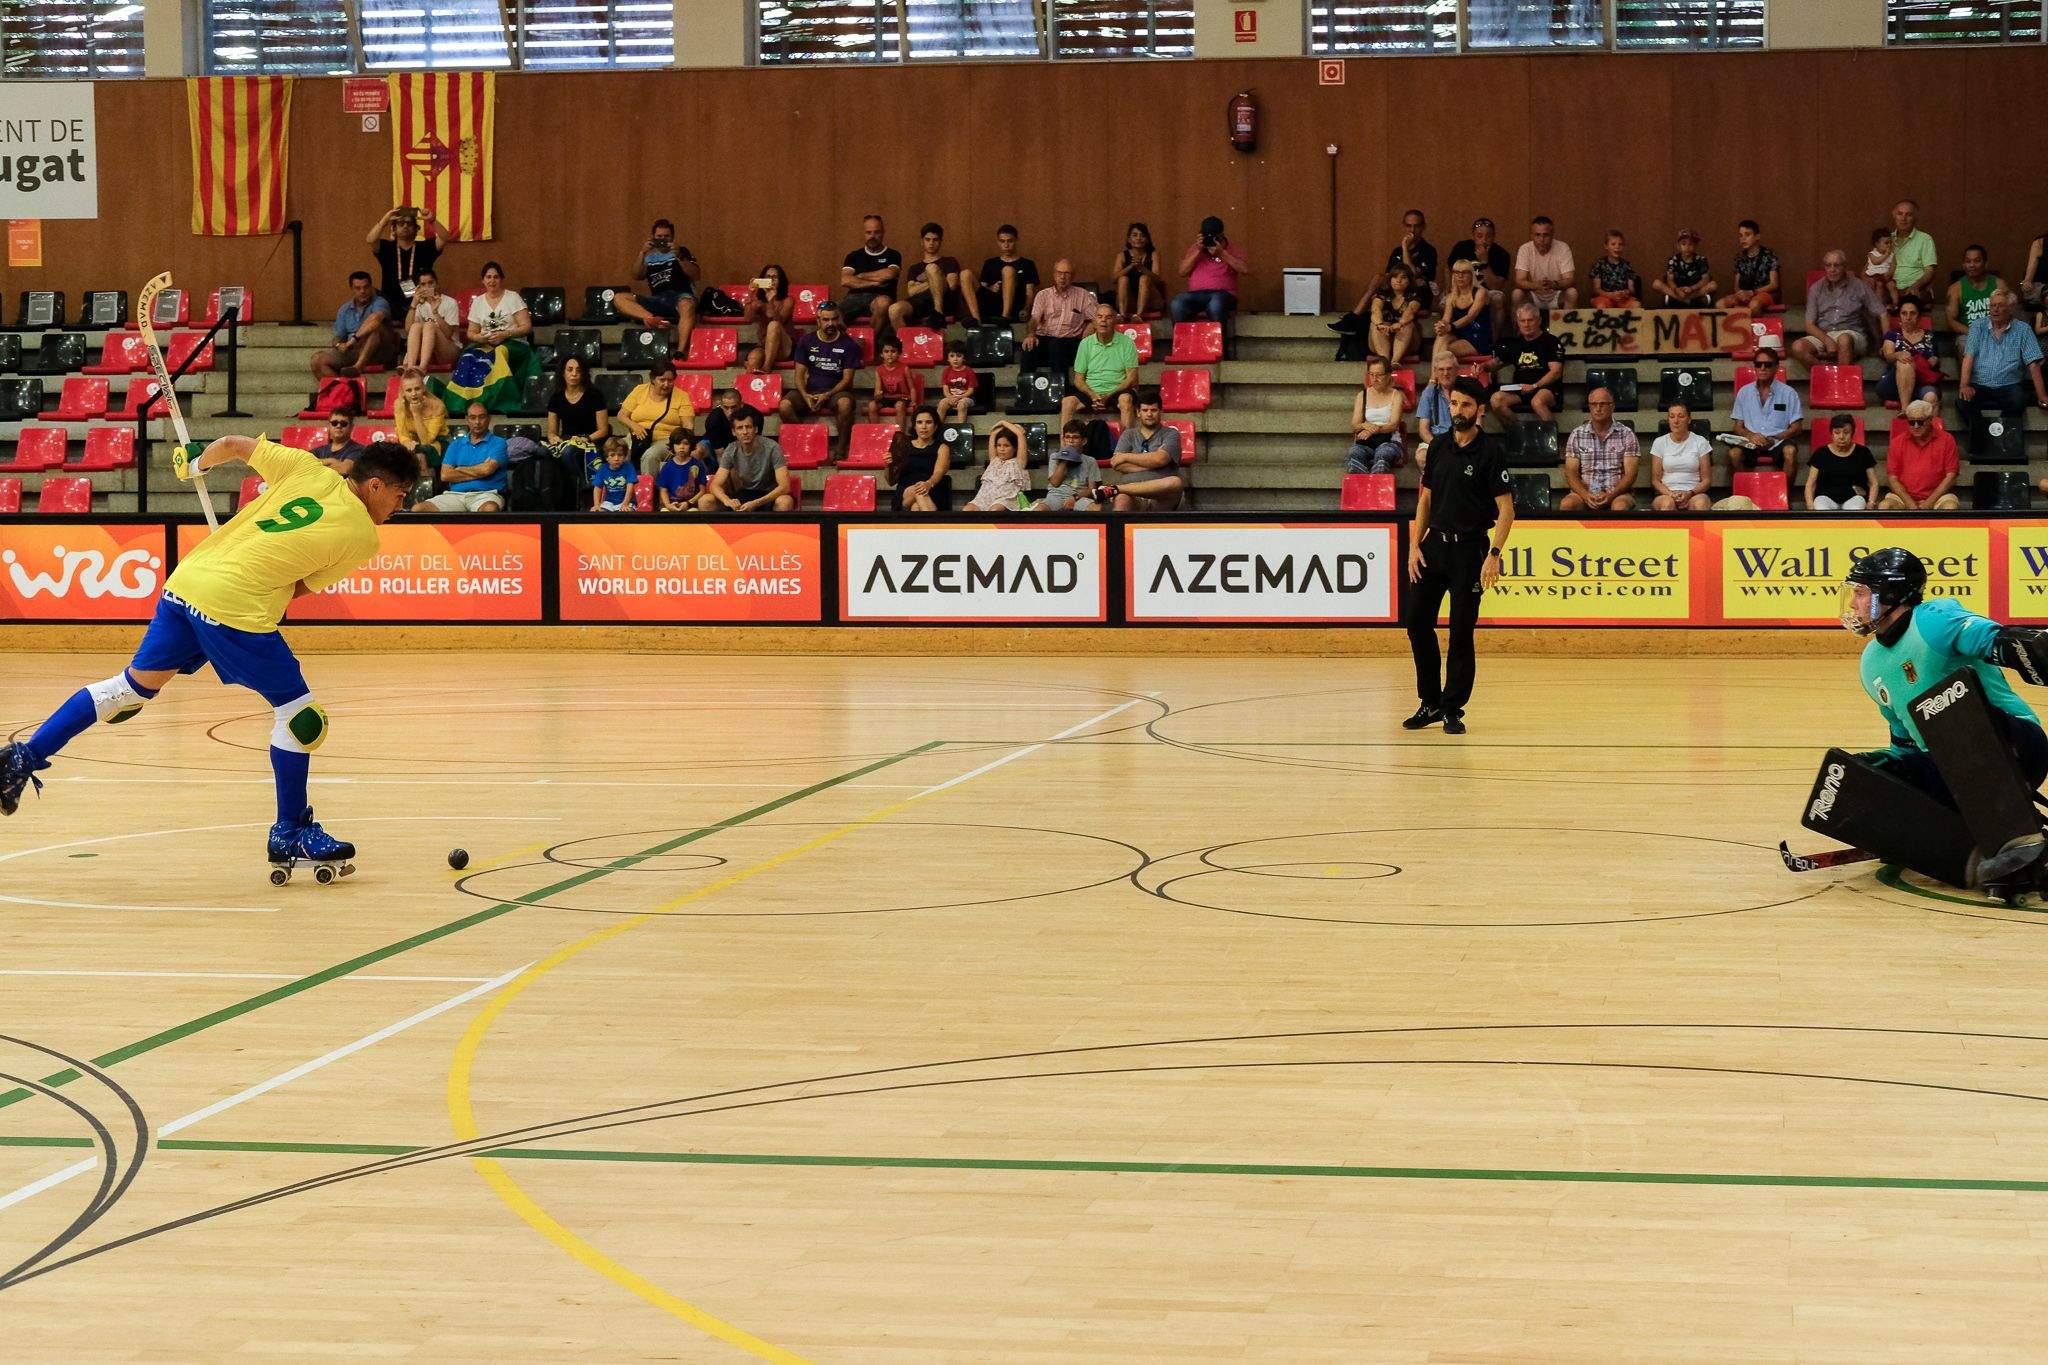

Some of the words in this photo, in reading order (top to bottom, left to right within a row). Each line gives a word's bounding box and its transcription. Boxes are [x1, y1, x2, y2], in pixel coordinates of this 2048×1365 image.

[0, 119, 42, 143] NT
[51, 119, 85, 143] DE
[1653, 311, 1752, 352] MATS
[254, 496, 324, 533] 9
[420, 554, 453, 571] DEL
[458, 550, 524, 571] VALLÈS
[577, 554, 626, 571] SANT
[631, 554, 690, 571] CUGAT
[696, 554, 731, 571] DEL
[735, 550, 802, 571] VALLÈS
[1550, 546, 1679, 578] Street
[1733, 546, 1833, 578] Wall
[1848, 546, 1978, 578] Seet
[317, 577, 373, 595] ORLD
[379, 577, 451, 595] ROLLER
[456, 577, 524, 595] GAMES
[577, 577, 648, 595] WORLD
[655, 577, 727, 595] ROLLER
[733, 577, 802, 595] GAMES
[1915, 680, 1969, 721] Reno
[1808, 763, 1846, 822] Reno
